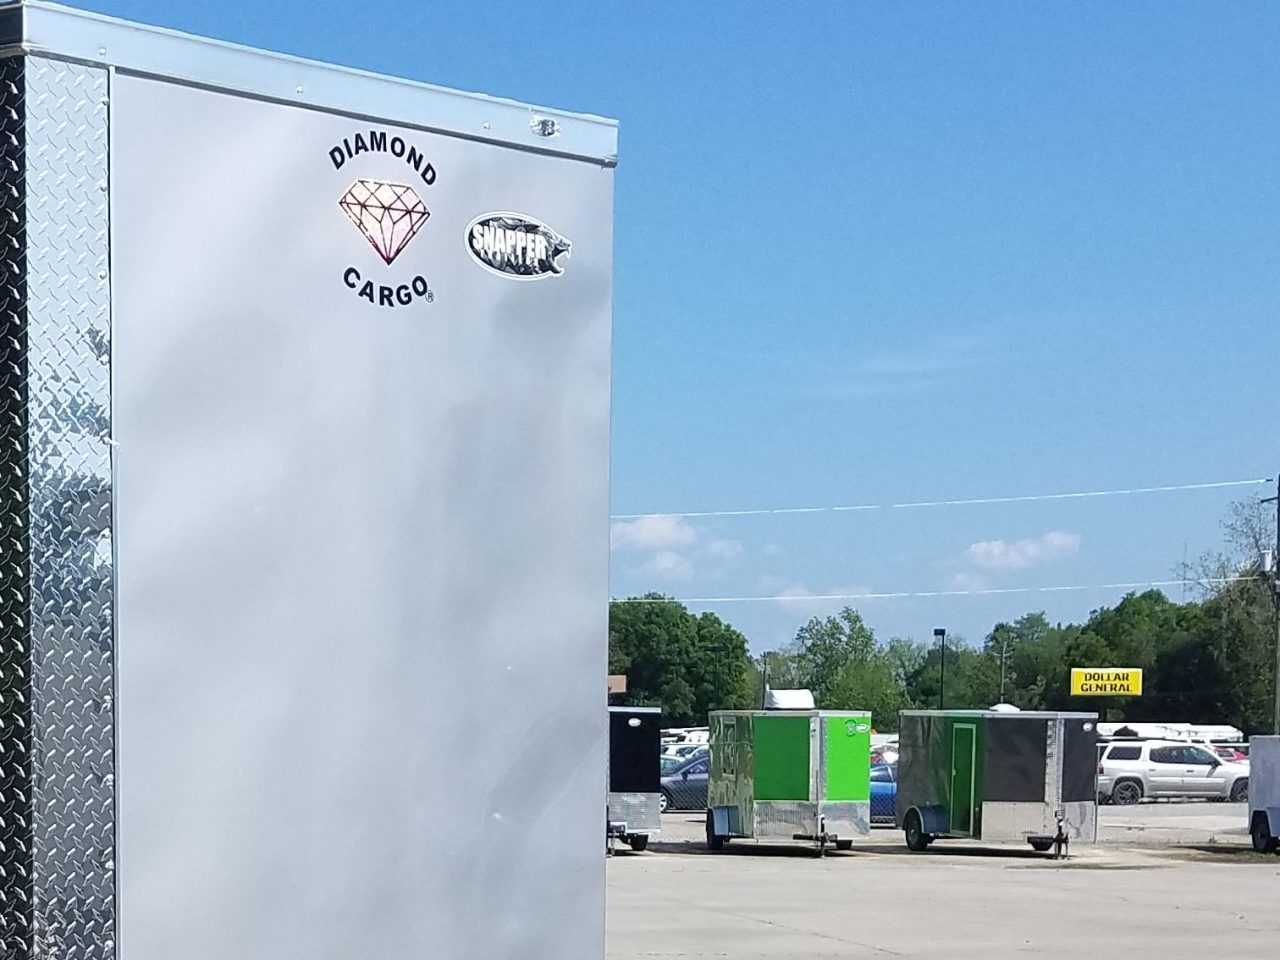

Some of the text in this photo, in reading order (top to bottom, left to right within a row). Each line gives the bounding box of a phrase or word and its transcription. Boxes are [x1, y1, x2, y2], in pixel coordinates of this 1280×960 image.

[328, 130, 437, 187] DIAMOND
[472, 223, 549, 266] SNAPPER
[343, 267, 428, 307] CARGO
[1080, 683, 1131, 692] GENERAL
[1084, 672, 1129, 682] DOLLAR
